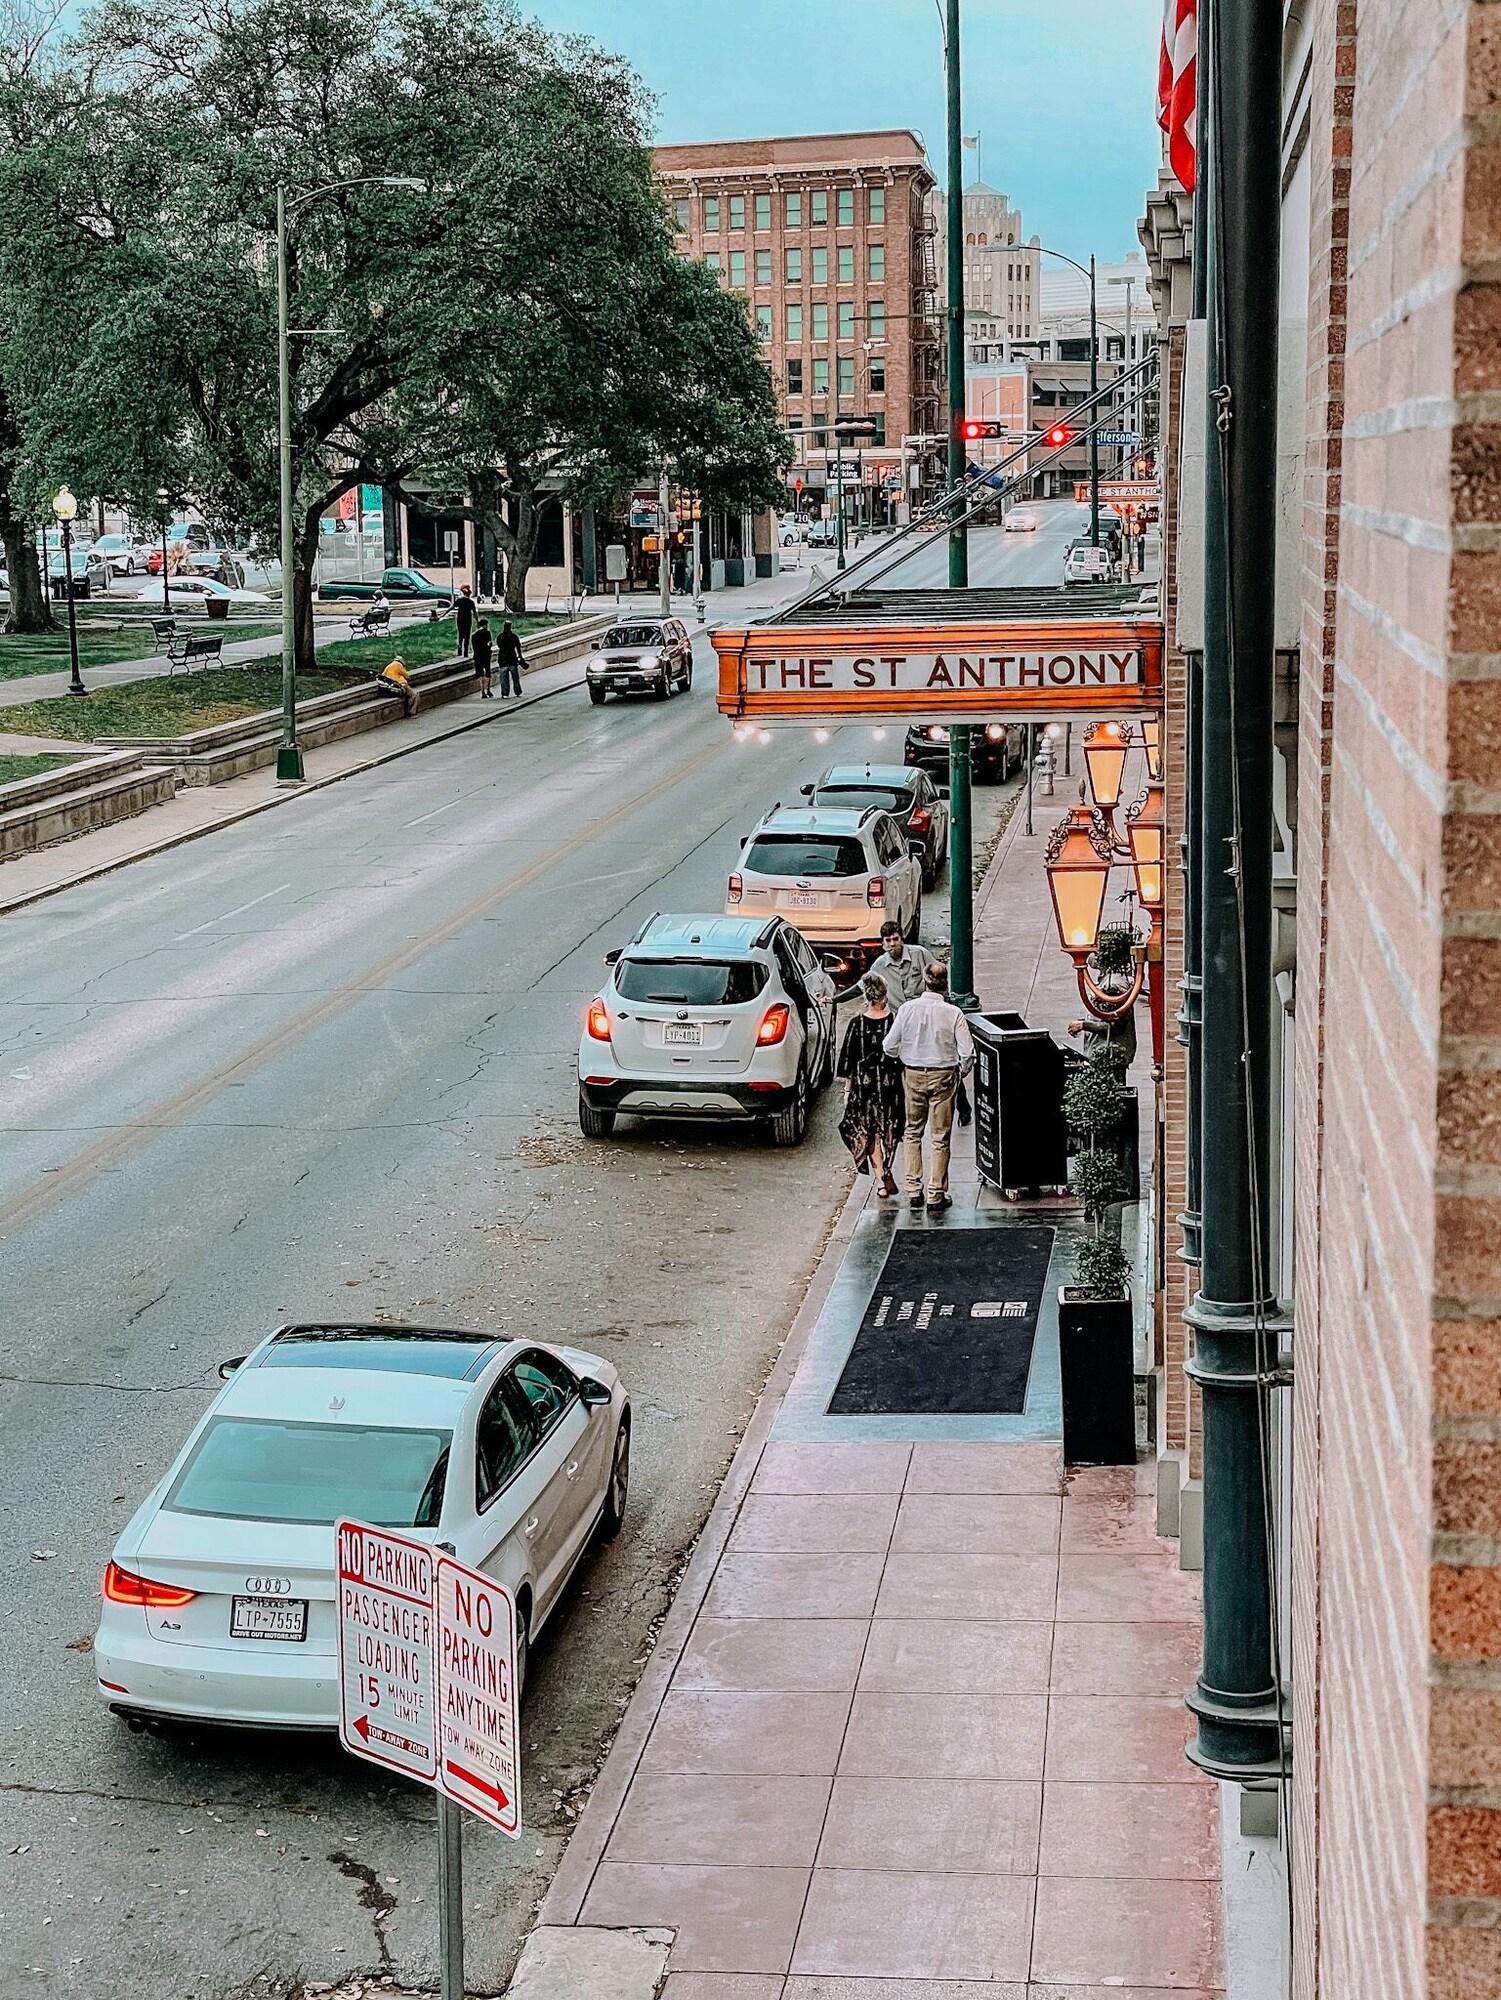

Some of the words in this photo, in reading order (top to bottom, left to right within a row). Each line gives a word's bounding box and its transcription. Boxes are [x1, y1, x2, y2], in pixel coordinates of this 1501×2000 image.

[1095, 431, 1131, 442] efferson
[749, 658, 833, 689] THE
[853, 658, 906, 688] ST
[926, 652, 1134, 688] ANTHONY
[896, 1301, 915, 1321] HOTEL
[938, 1304, 955, 1316] THE
[341, 1528, 362, 1576] NO
[368, 1541, 428, 1596] PARKING
[256, 1601, 285, 1609] TEXAS
[345, 1589, 430, 1648] PASSENGER
[455, 1579, 493, 1638] NO
[160, 1620, 182, 1630] A3
[358, 1633, 420, 1685] LOADING
[443, 1626, 508, 1703] PARKING
[358, 1672, 381, 1709] 15
[388, 1683, 425, 1709] MINUTE
[393, 1701, 419, 1725] LIMIT
[447, 1683, 507, 1747] ANYTIME
[407, 1738, 429, 1758] ZONE
[443, 1723, 460, 1747] TOW
[463, 1733, 485, 1761] AWAY
[489, 1750, 513, 1781] ZONE
